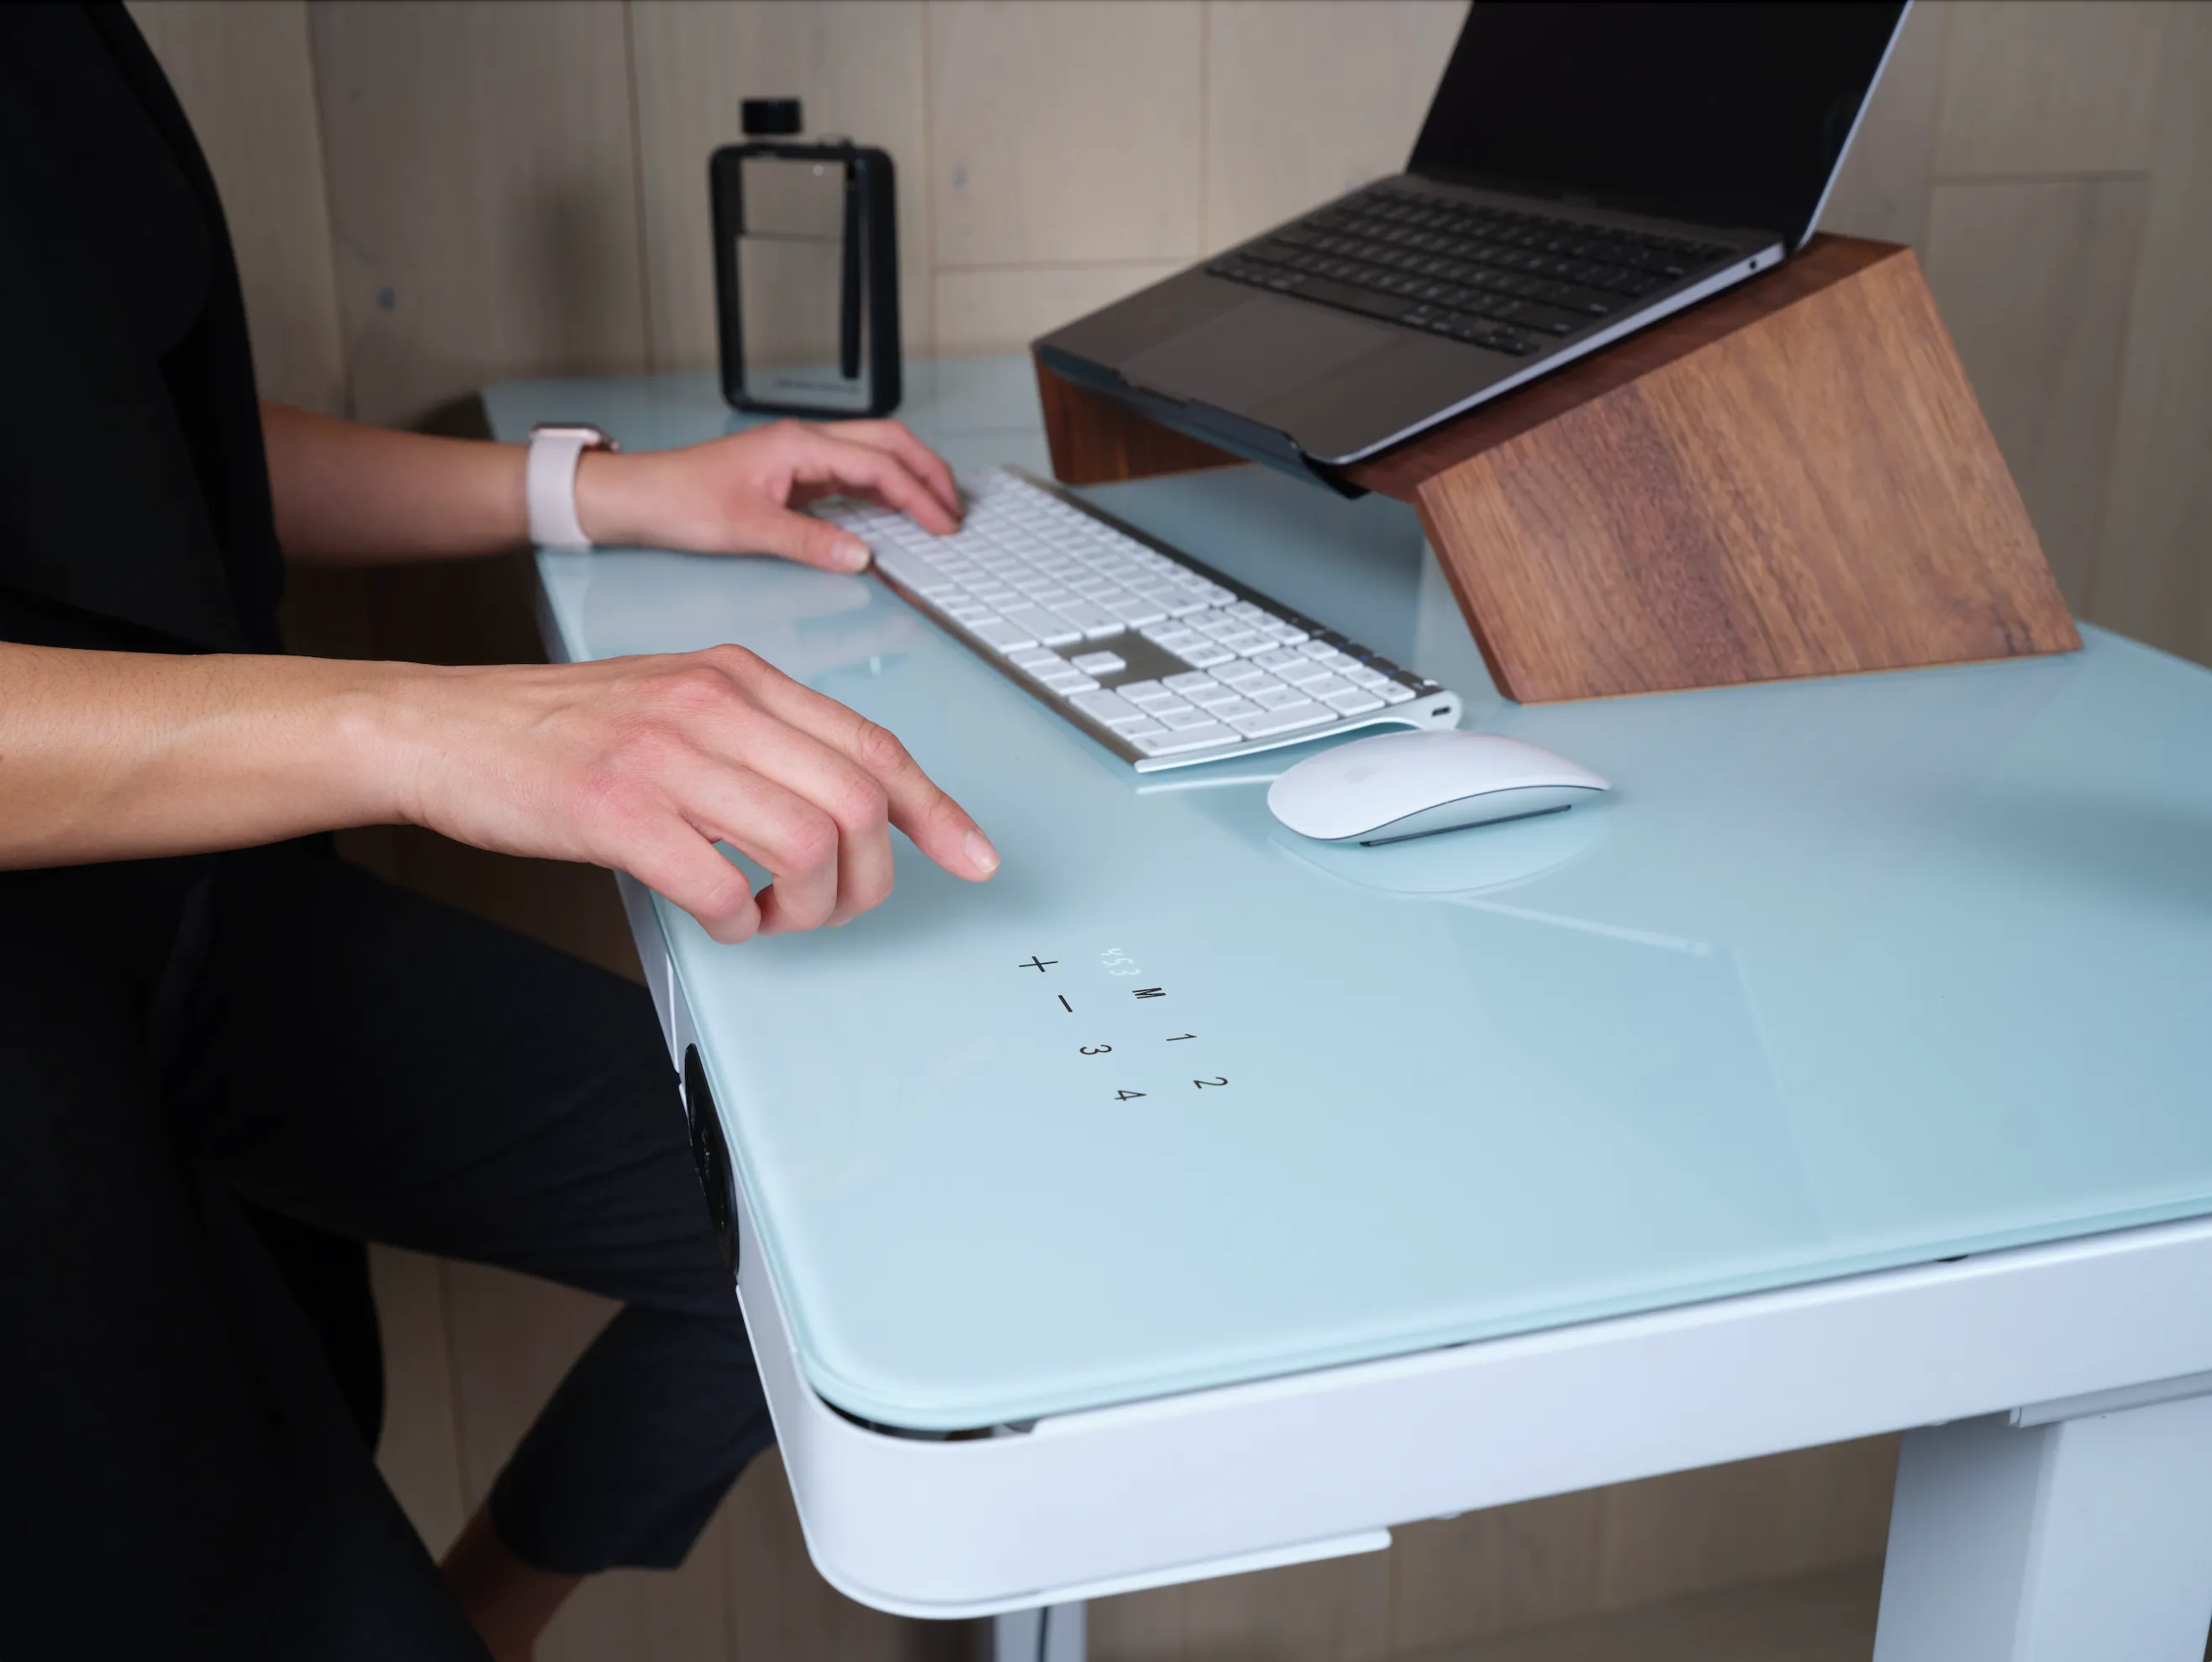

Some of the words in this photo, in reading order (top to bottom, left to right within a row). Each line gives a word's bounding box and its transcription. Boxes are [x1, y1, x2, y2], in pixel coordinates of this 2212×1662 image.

[1131, 986, 1167, 1000] M
[1166, 1033, 1198, 1042] 1
[1079, 1044, 1113, 1056] 3
[1193, 1076, 1229, 1090] 2
[1114, 1089, 1147, 1102] 4
